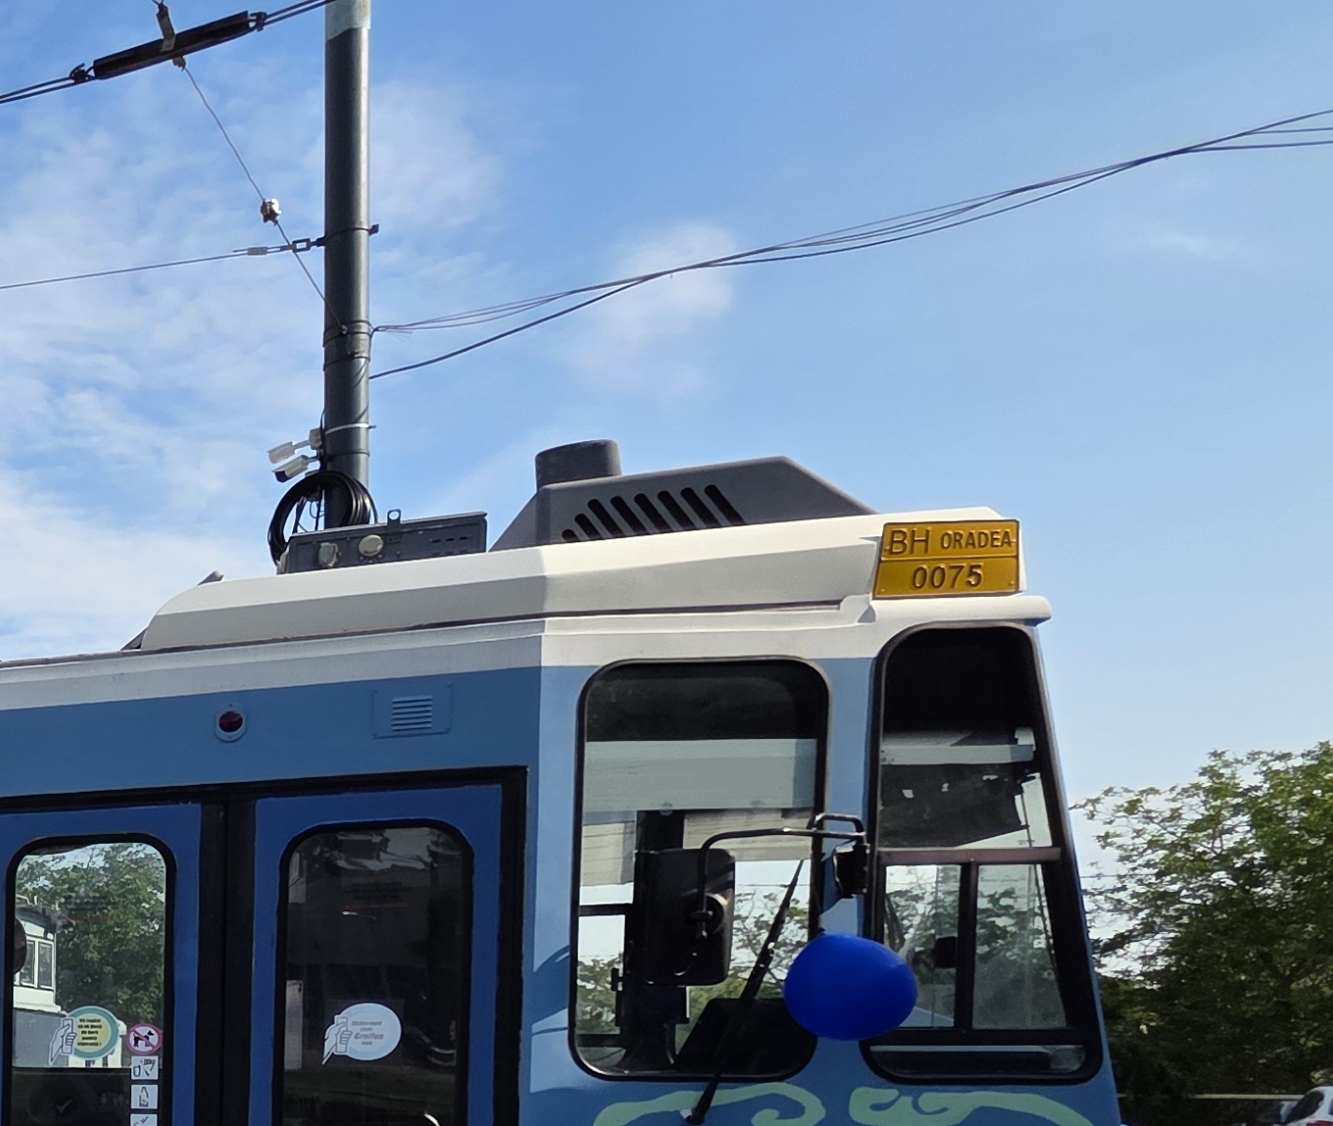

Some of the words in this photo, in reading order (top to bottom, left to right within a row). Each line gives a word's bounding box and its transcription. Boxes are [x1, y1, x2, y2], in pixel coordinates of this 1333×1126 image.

[889, 527, 931, 555] BH
[940, 529, 1013, 550] ORADEA
[912, 563, 984, 590] 0075
